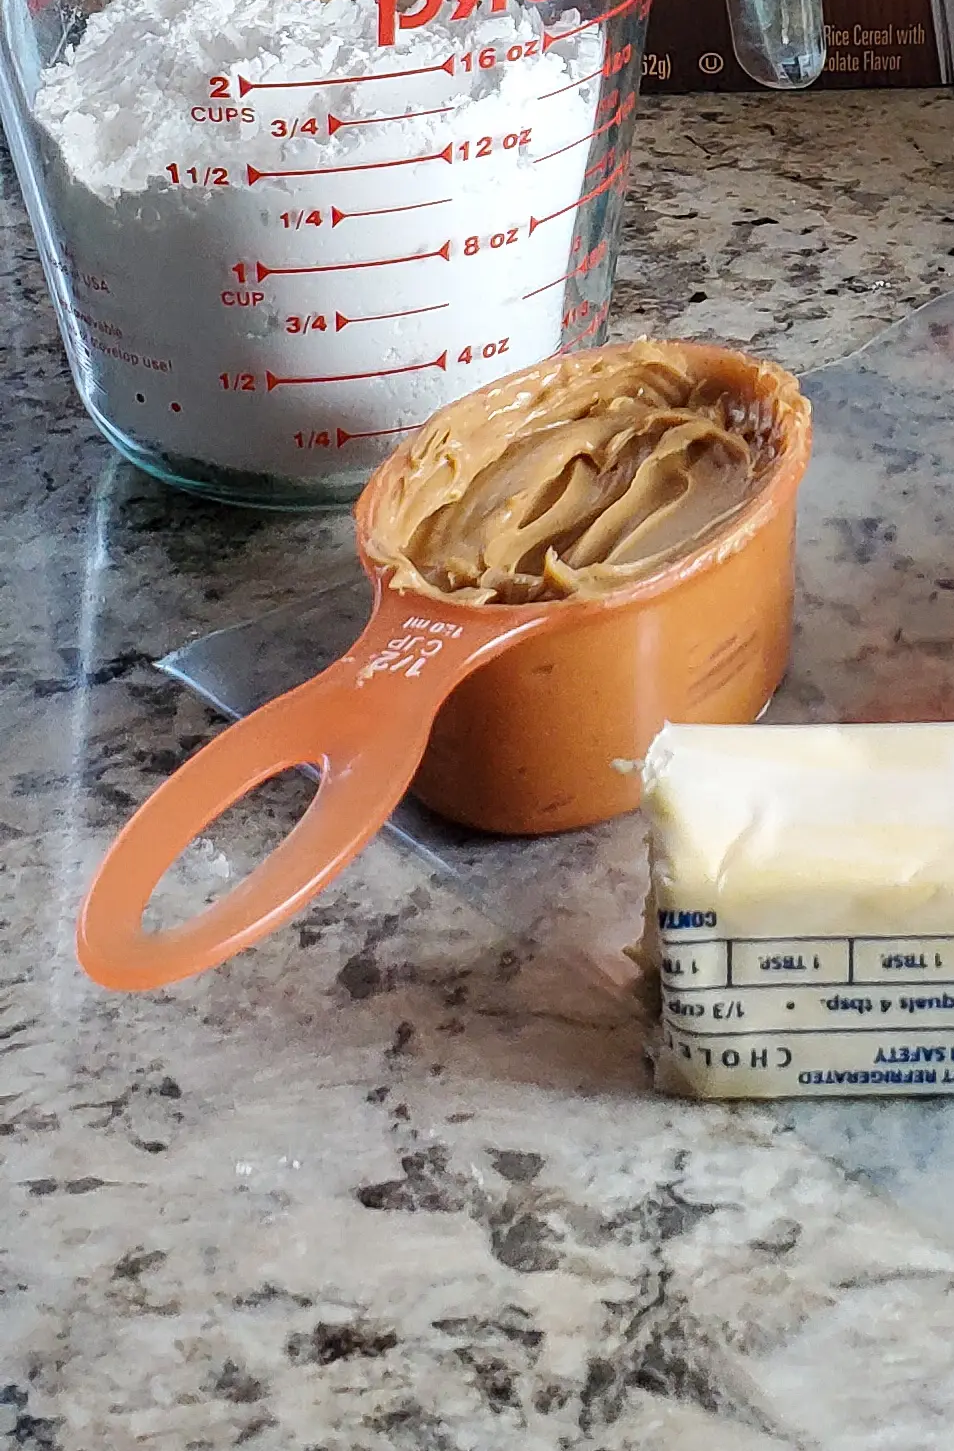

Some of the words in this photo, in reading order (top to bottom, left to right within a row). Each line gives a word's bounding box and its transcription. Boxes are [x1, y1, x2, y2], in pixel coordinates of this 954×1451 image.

[823, 24, 850, 47] Rice
[853, 23, 893, 46] Cereal
[896, 23, 926, 45] with
[460, 47, 497, 73] 16
[507, 39, 539, 63] oz
[863, 50, 902, 72] Flavor
[208, 77, 231, 99] 2
[190, 105, 256, 124] CUPS
[270, 117, 319, 139] 3/4
[458, 136, 493, 162] 12
[502, 127, 533, 149] oz
[279, 209, 323, 229] 1/4
[463, 235, 478, 256] 8
[490, 228, 519, 247] oz
[231, 262, 246, 284] 1
[220, 291, 265, 307] CUP
[285, 314, 328, 334] 3/4
[457, 345, 473, 366] 4
[482, 337, 510, 357] oz
[218, 371, 256, 392] 1/2
[293, 429, 330, 449] 1/4
[668, 999, 705, 1017] cup
[712, 1000, 745, 1020] 1/3
[880, 998, 892, 1013] 4
[873, 1045, 947, 1064] SAFETY
[798, 1068, 937, 1085] REFRIGERATED
